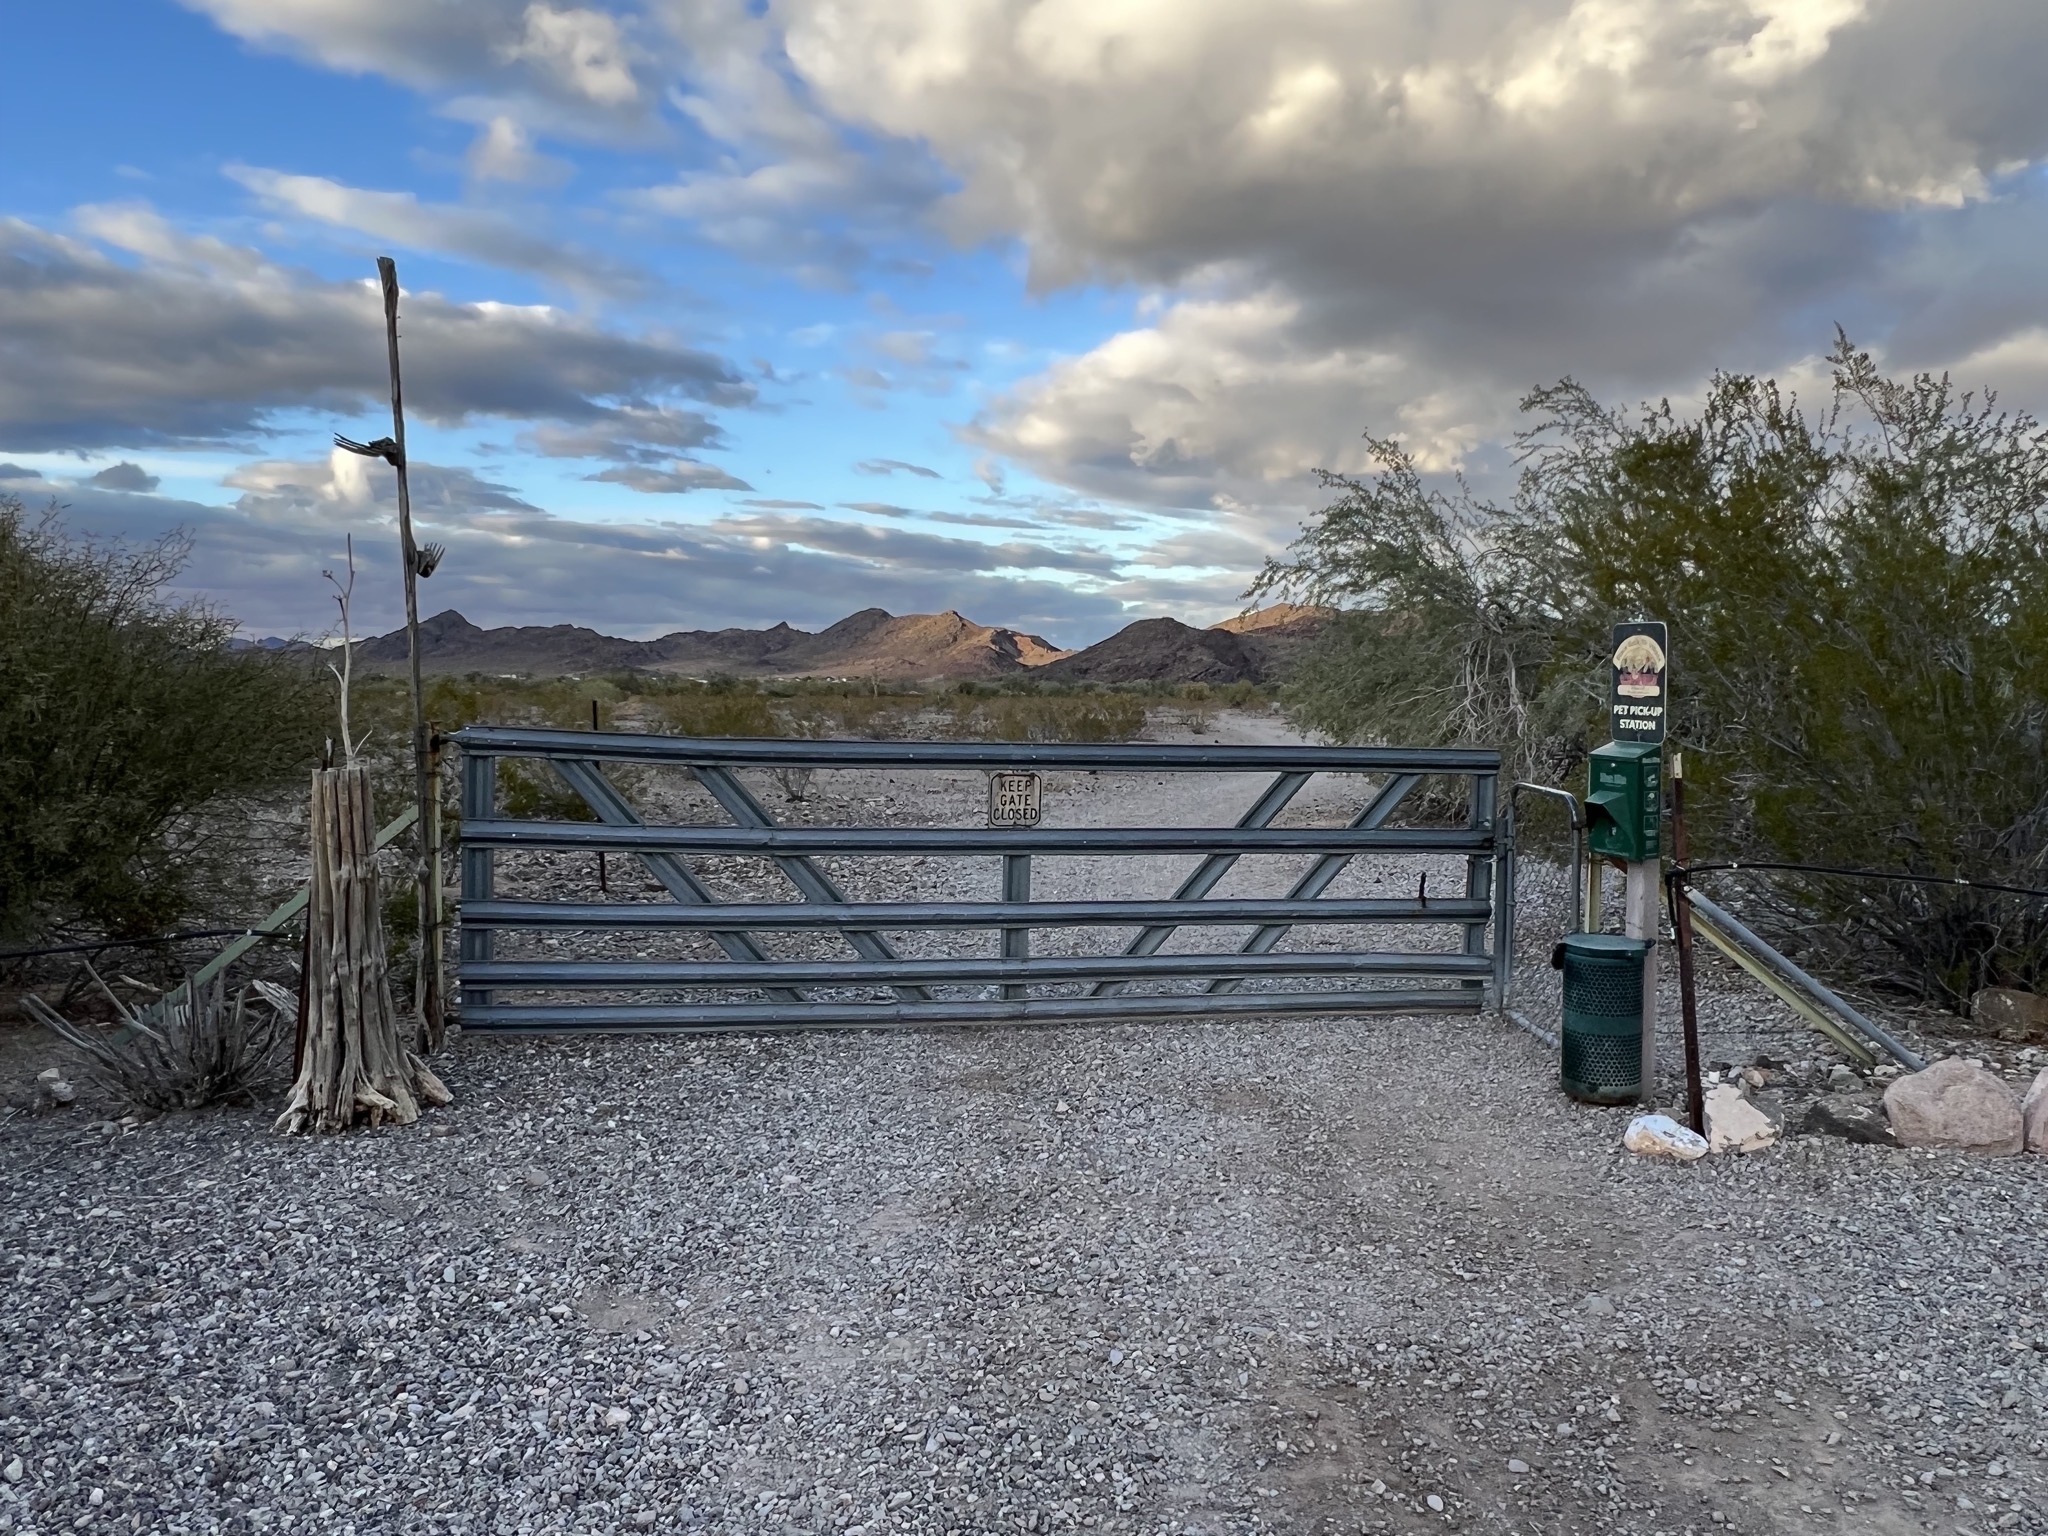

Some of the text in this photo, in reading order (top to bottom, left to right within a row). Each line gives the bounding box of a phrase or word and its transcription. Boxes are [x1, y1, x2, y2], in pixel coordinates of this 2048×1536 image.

[1613, 704, 1663, 717] PET PICK-UP
[1619, 718, 1656, 730] STATION
[1000, 779, 1032, 792] KEEP
[1000, 794, 1031, 807] GATE
[993, 808, 1038, 821] CLOSED
